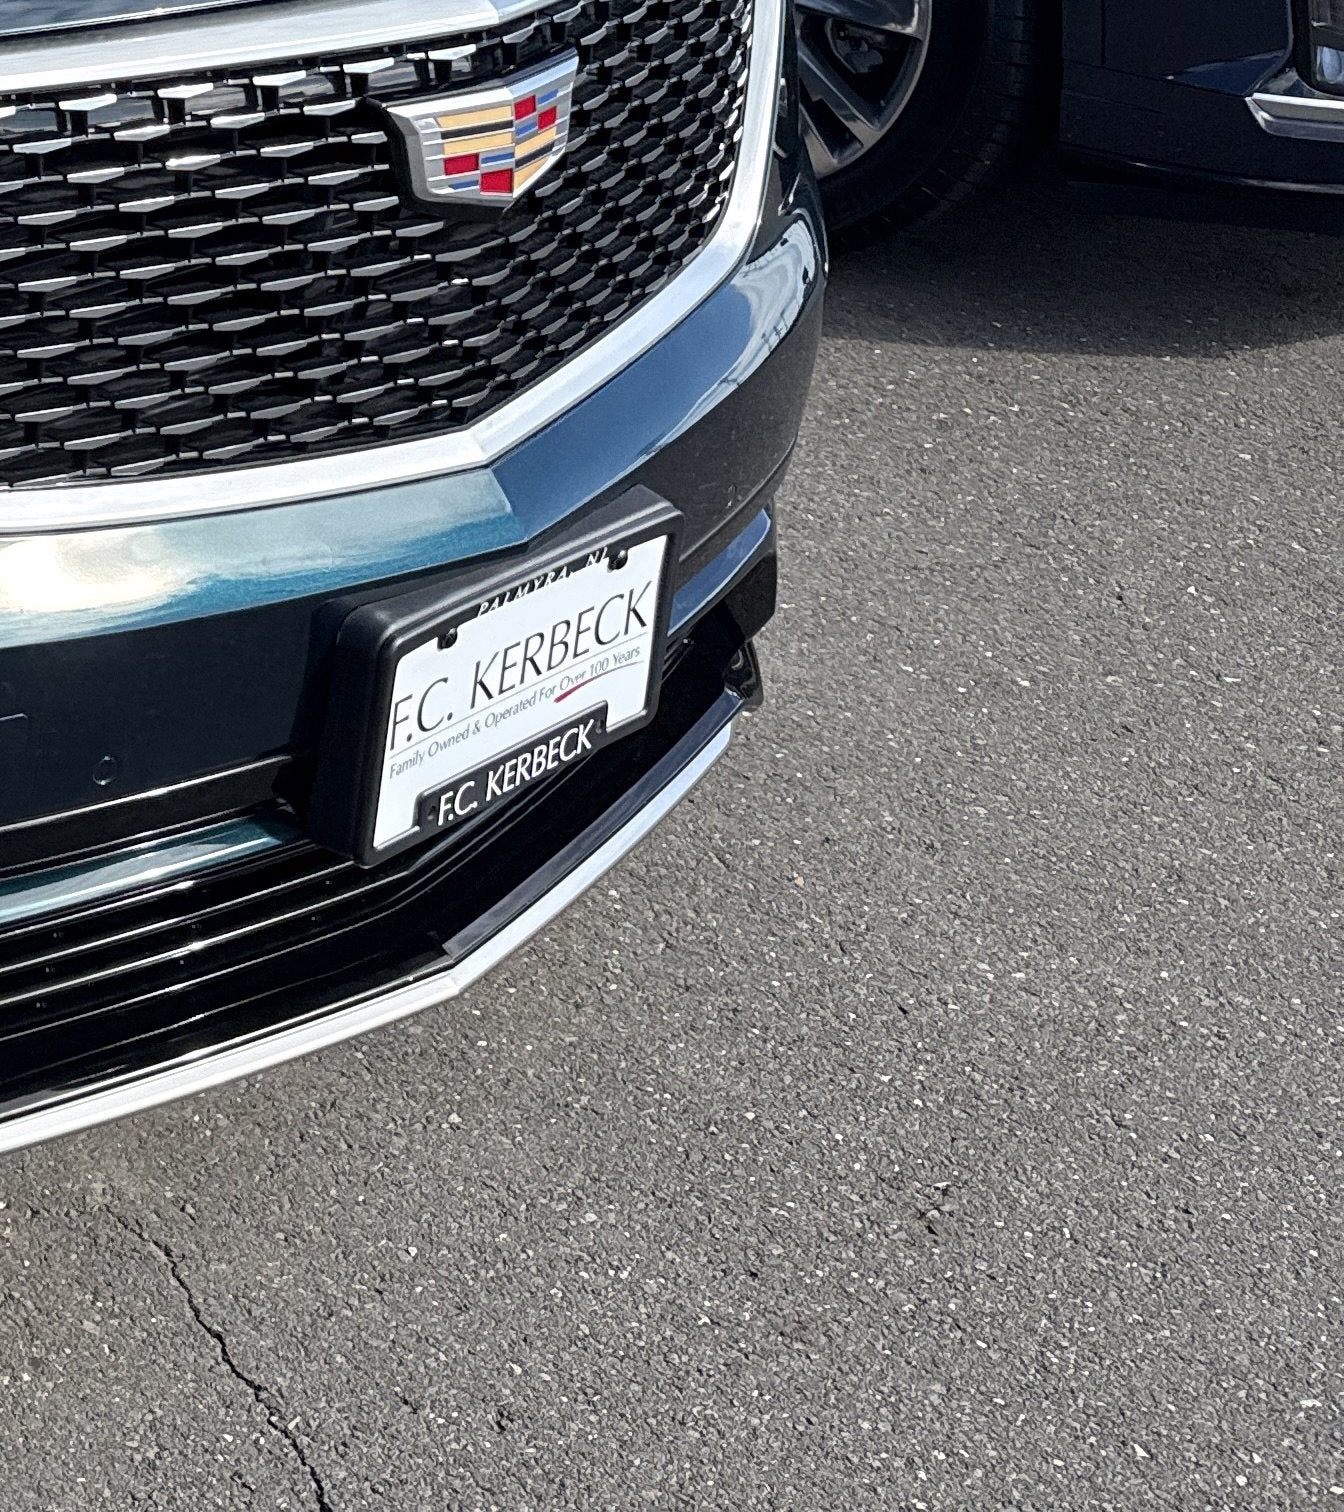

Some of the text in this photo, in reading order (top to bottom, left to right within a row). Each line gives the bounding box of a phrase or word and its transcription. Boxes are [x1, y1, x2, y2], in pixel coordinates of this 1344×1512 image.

[389, 580, 653, 751] F.C. KERBECK
[389, 646, 641, 779] Family Owned & Operated For Over 100 Years
[437, 718, 595, 827] F.C. KERBECK
